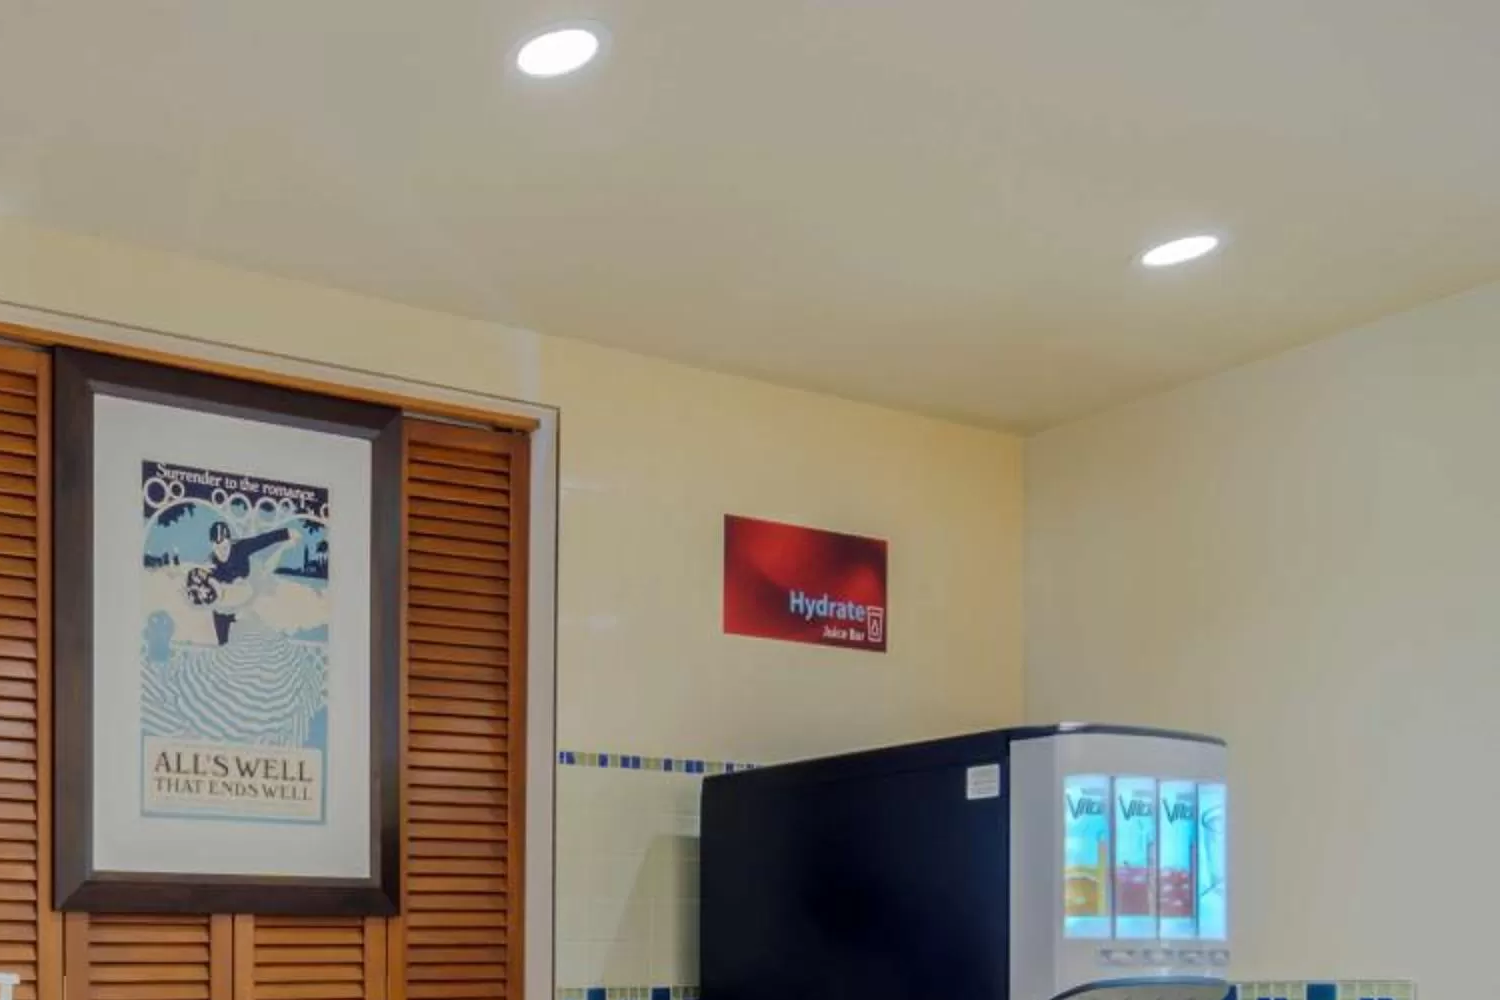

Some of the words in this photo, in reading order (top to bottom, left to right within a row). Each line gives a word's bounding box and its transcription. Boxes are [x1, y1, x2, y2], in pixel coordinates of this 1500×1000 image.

[156, 462, 223, 487] Surrender
[224, 475, 237, 489] to
[239, 476, 260, 493] the
[789, 589, 867, 622] Hydrate
[823, 624, 848, 640] Juice
[849, 628, 866, 641] Bar
[154, 751, 230, 778] ALL'S
[235, 756, 313, 782] WELL
[153, 776, 204, 794] THAT
[208, 780, 259, 797] ENDS
[261, 784, 313, 801] WELL
